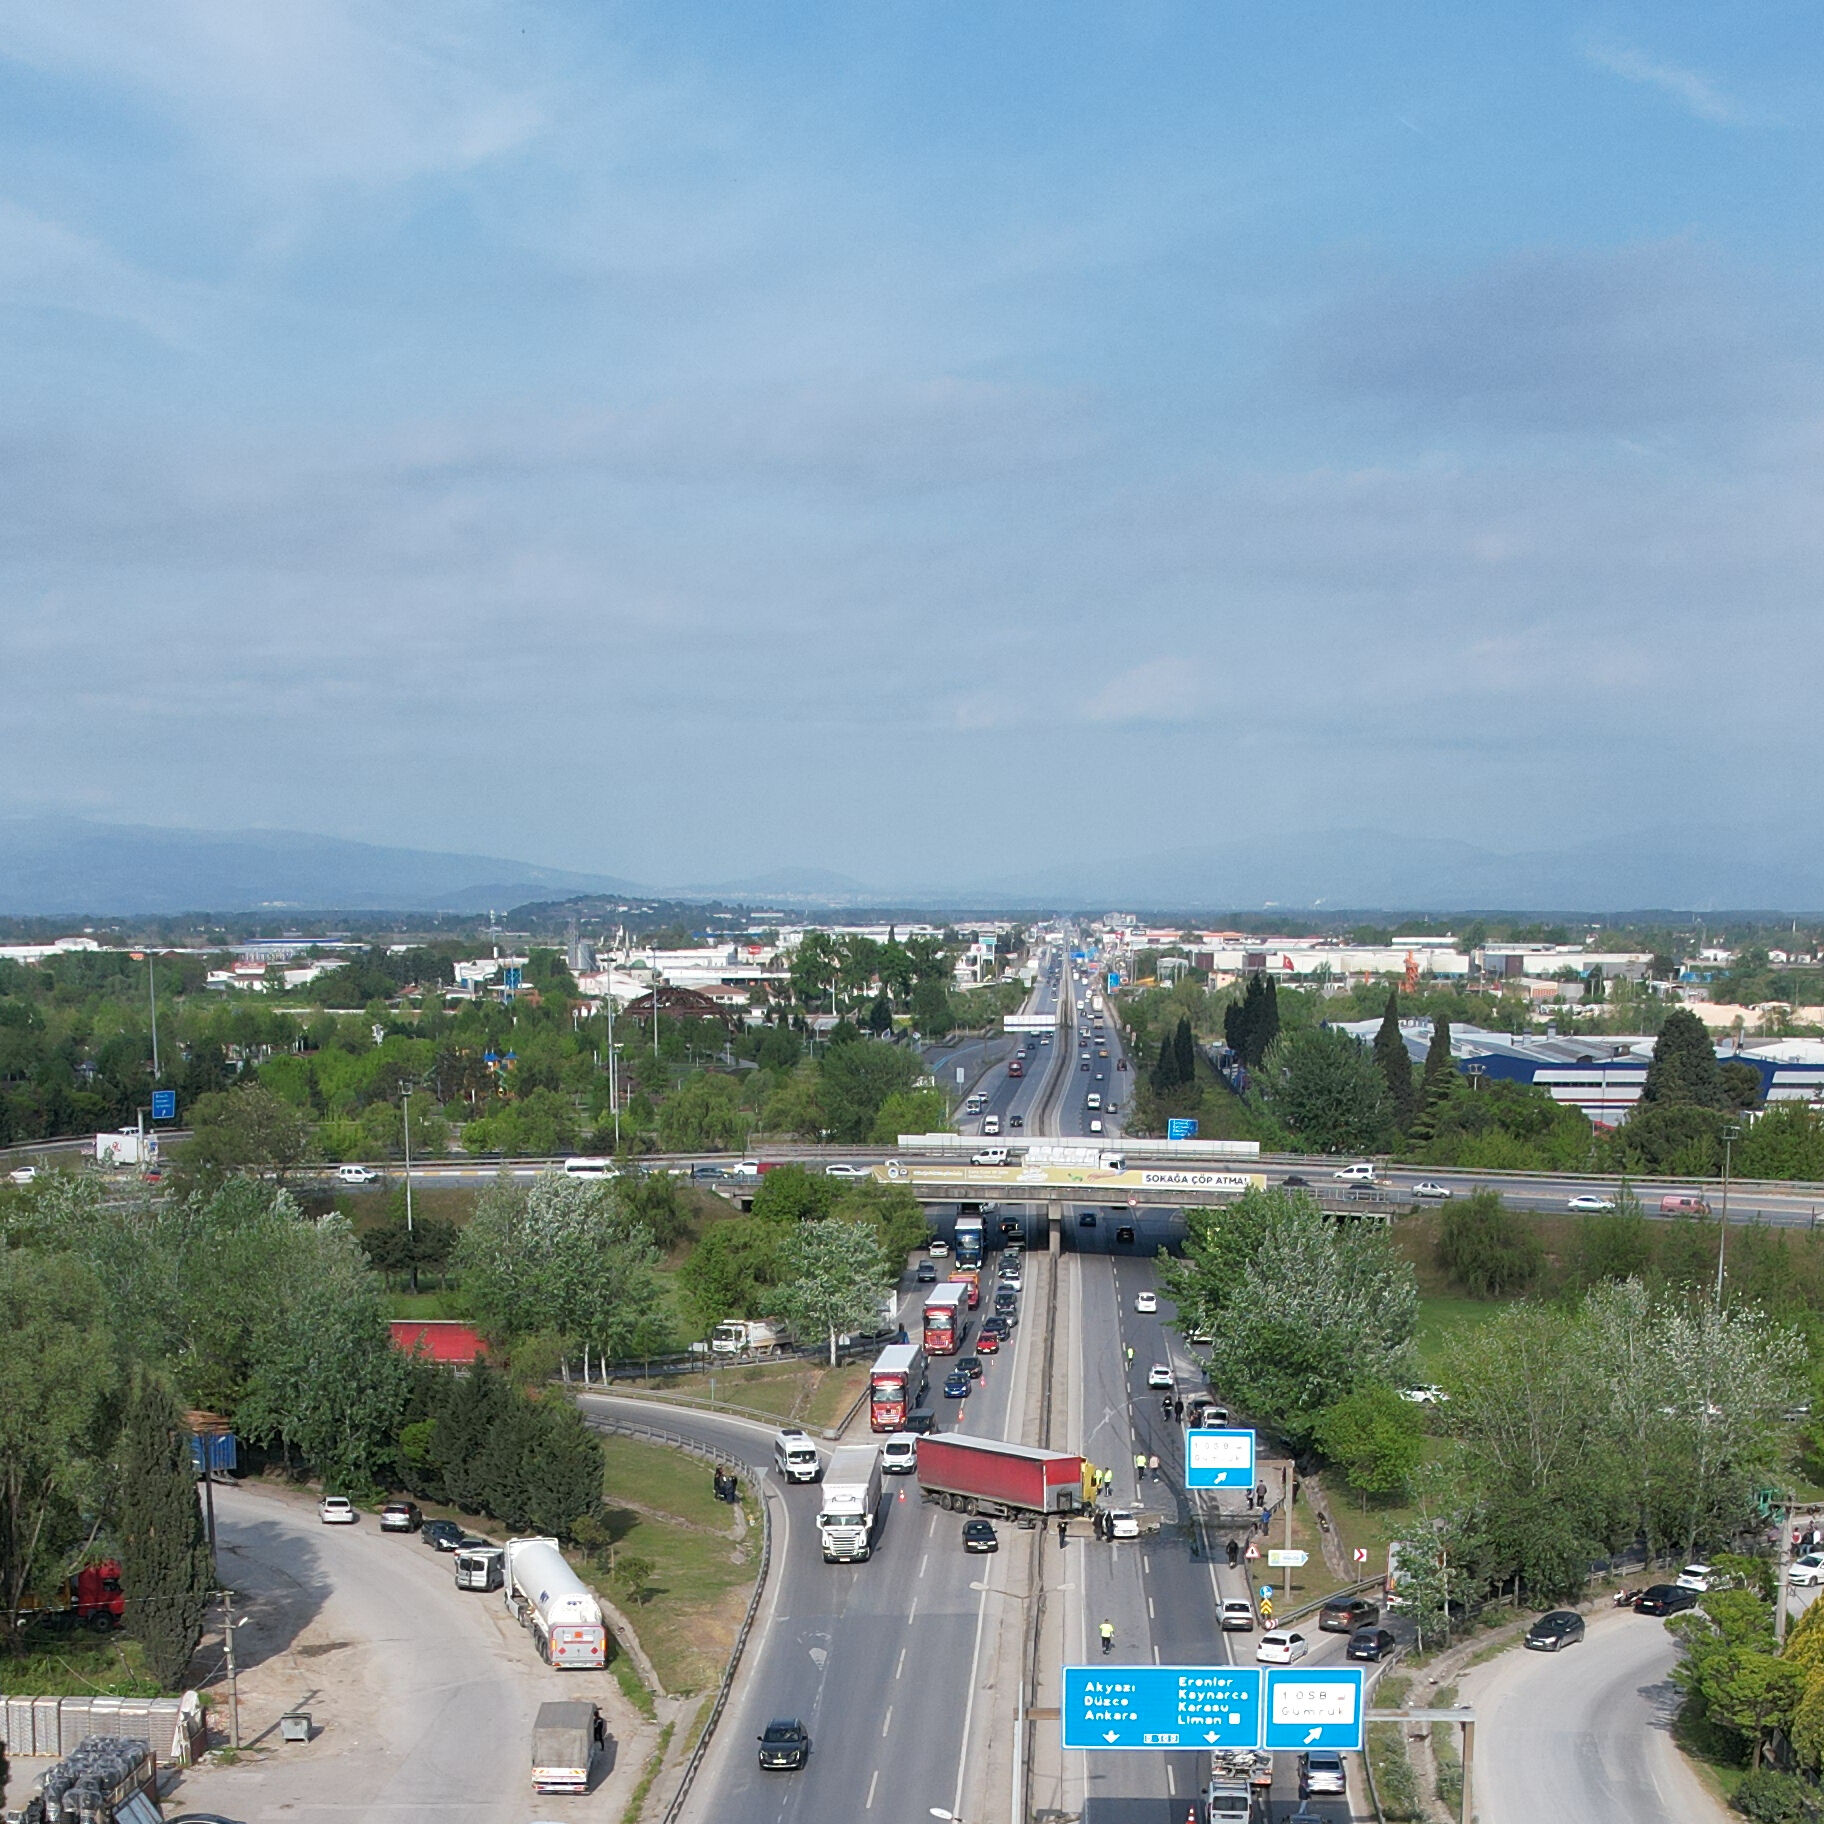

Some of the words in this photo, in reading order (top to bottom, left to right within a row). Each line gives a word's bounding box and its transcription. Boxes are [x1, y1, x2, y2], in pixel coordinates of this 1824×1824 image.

[1146, 1173, 1188, 1183] SOKAĞA
[1191, 1174, 1213, 1185] ÇÖP
[1178, 1677, 1234, 1687] Erenler
[1178, 1689, 1249, 1702] Kaynarca
[1178, 1702, 1229, 1712] Karasu
[1084, 1710, 1138, 1721] Ankara
[1177, 1715, 1223, 1725] Liman
